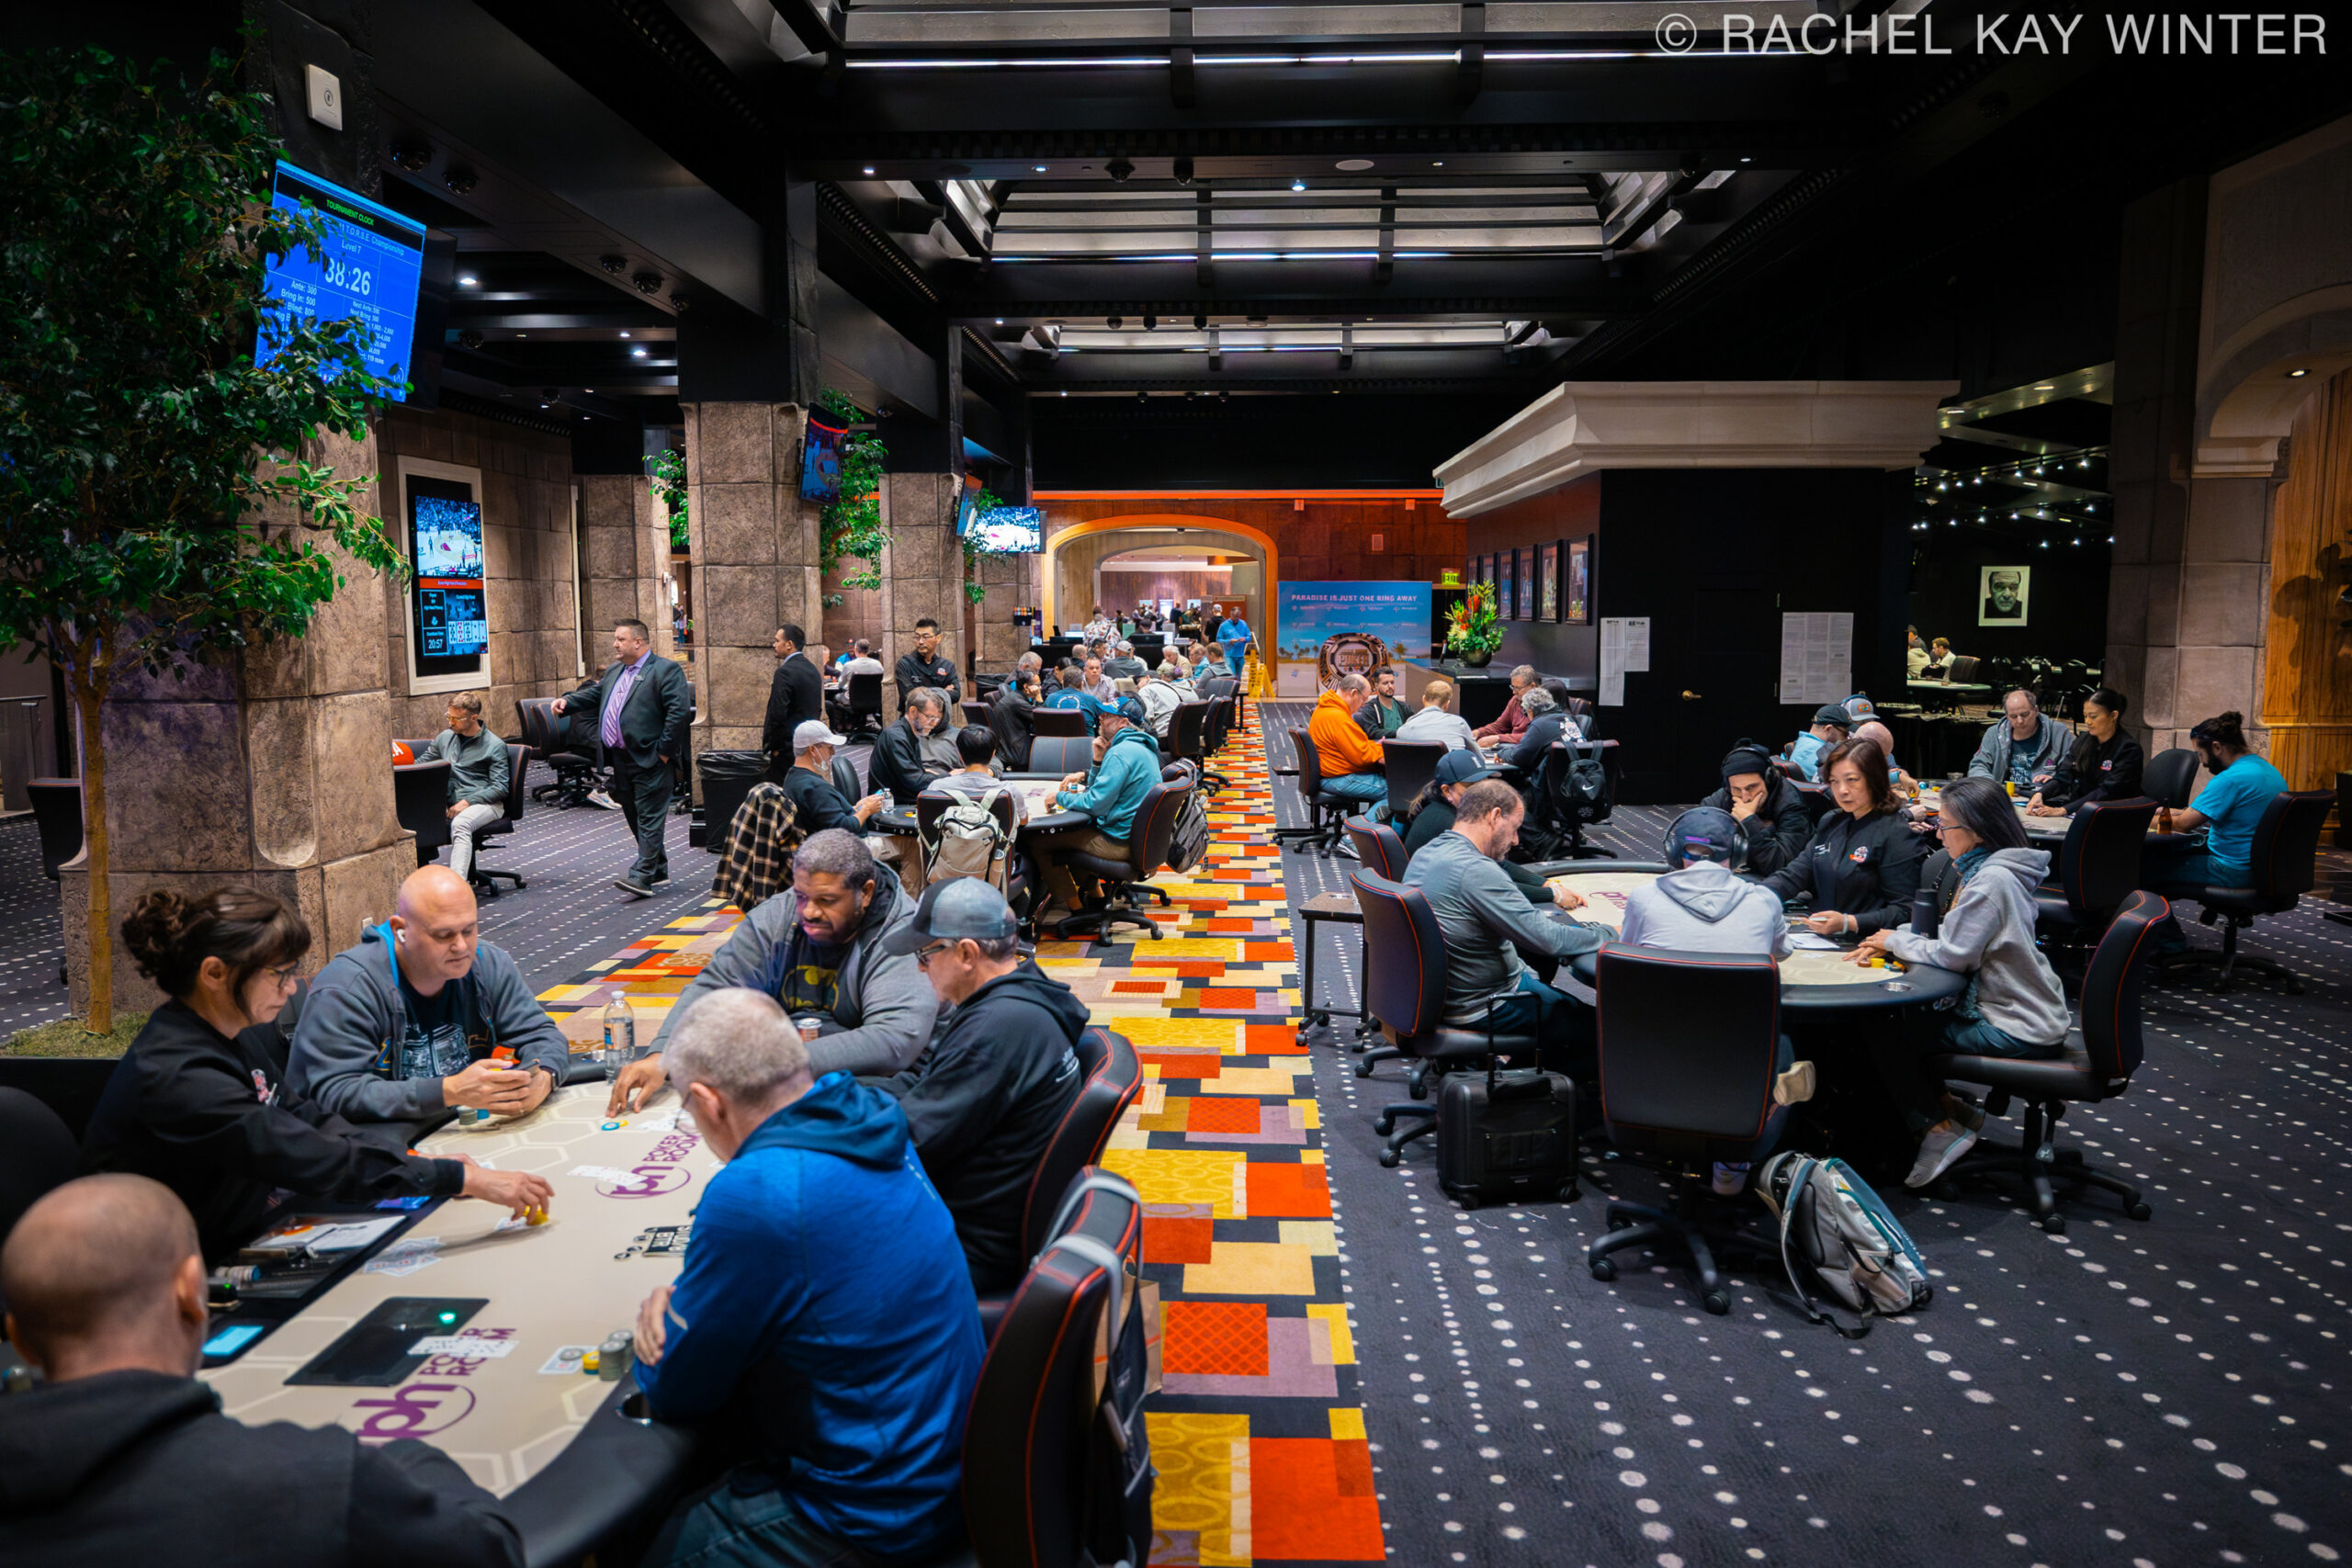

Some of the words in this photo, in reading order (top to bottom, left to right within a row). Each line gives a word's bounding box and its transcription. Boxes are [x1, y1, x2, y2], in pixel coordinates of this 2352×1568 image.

[326, 199, 357, 220] TOURNAMENT
[358, 213, 374, 226] CLOCK
[342, 240, 356, 252] Level
[357, 246, 361, 254] 7
[371, 236, 404, 256] Championship
[325, 257, 371, 296] 38:26
[281, 288, 296, 301] Bring
[297, 294, 305, 303] In:
[306, 296, 316, 307] 500
[290, 280, 305, 291] Ante:
[307, 286, 318, 296] 300
[287, 302, 303, 313] Blind:
[1443, 573, 1459, 582] EXIT
[642, 1135, 684, 1161] POKER
